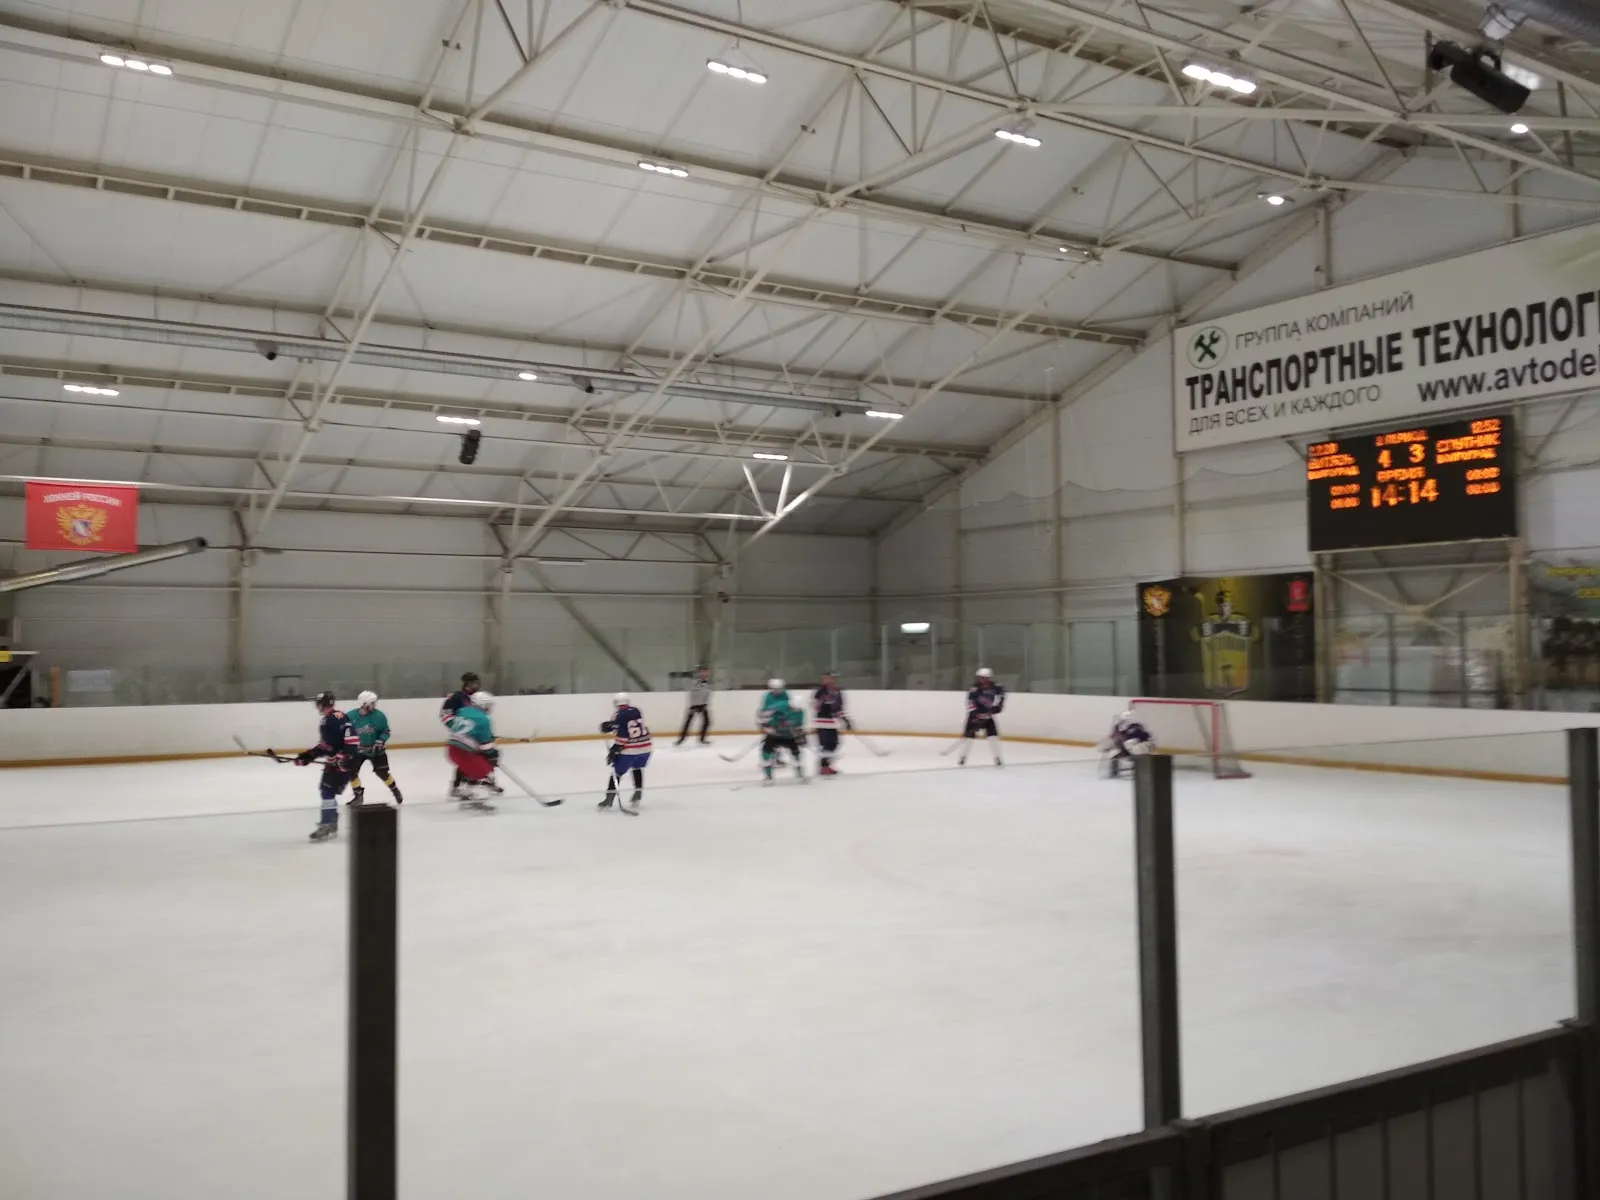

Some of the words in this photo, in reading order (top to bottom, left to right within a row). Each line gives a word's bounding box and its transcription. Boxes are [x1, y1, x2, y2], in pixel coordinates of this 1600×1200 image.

[1236, 322, 1301, 350] ГРУППА
[1306, 291, 1414, 333] КОМПАНИЙ
[1185, 332, 1403, 410] ТРАНСПОРТНЫЕ
[1412, 289, 1600, 367] ТЕХНОЛОГ
[1417, 345, 1600, 402] www.avtode
[1189, 413, 1221, 435] ДЛЯ
[1225, 404, 1269, 426] ВСЕХ
[1274, 402, 1285, 417] И
[1291, 384, 1381, 415] КАЖДОГО
[1378, 449, 1392, 468] 4
[1409, 443, 1425, 463] 3
[1370, 478, 1439, 508] 14:14
